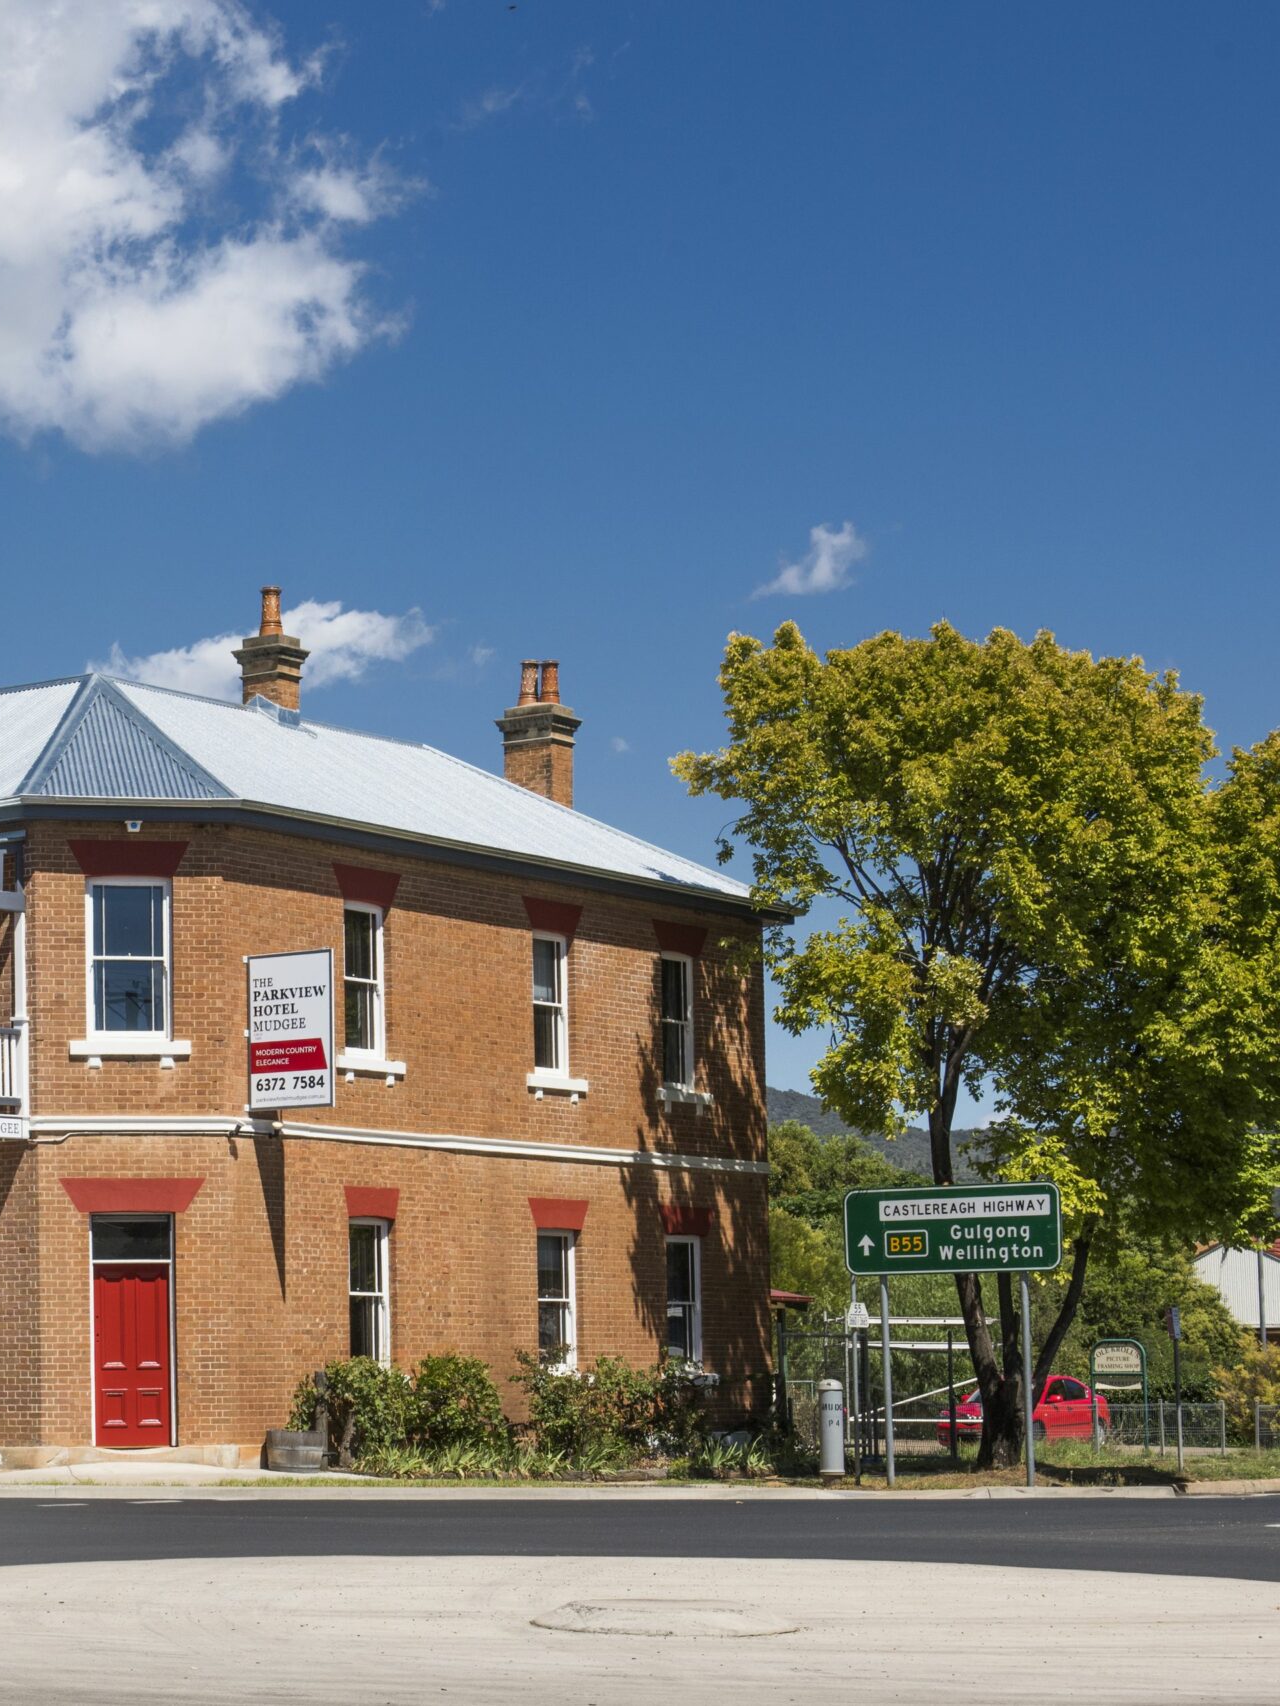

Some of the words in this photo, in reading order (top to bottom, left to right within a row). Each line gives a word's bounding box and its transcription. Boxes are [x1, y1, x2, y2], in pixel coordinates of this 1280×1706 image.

[253, 977, 273, 988] THE
[253, 985, 326, 1002] PARKVIEW
[253, 1003, 298, 1017] HOTEL
[253, 1017, 306, 1033] MUDGEE
[255, 1048, 284, 1057] MODERN
[285, 1046, 317, 1055] COUNTRY
[255, 1057, 290, 1067] ELEGANCE
[256, 1077, 286, 1092] 6372
[293, 1075, 325, 1090] 7584
[883, 1201, 976, 1217] CASTLEREAGH
[983, 1198, 1046, 1213] HIGHWAY
[950, 1224, 1030, 1242] Gulgong
[890, 1236, 923, 1252] B55
[939, 1243, 1044, 1263] Wellington
